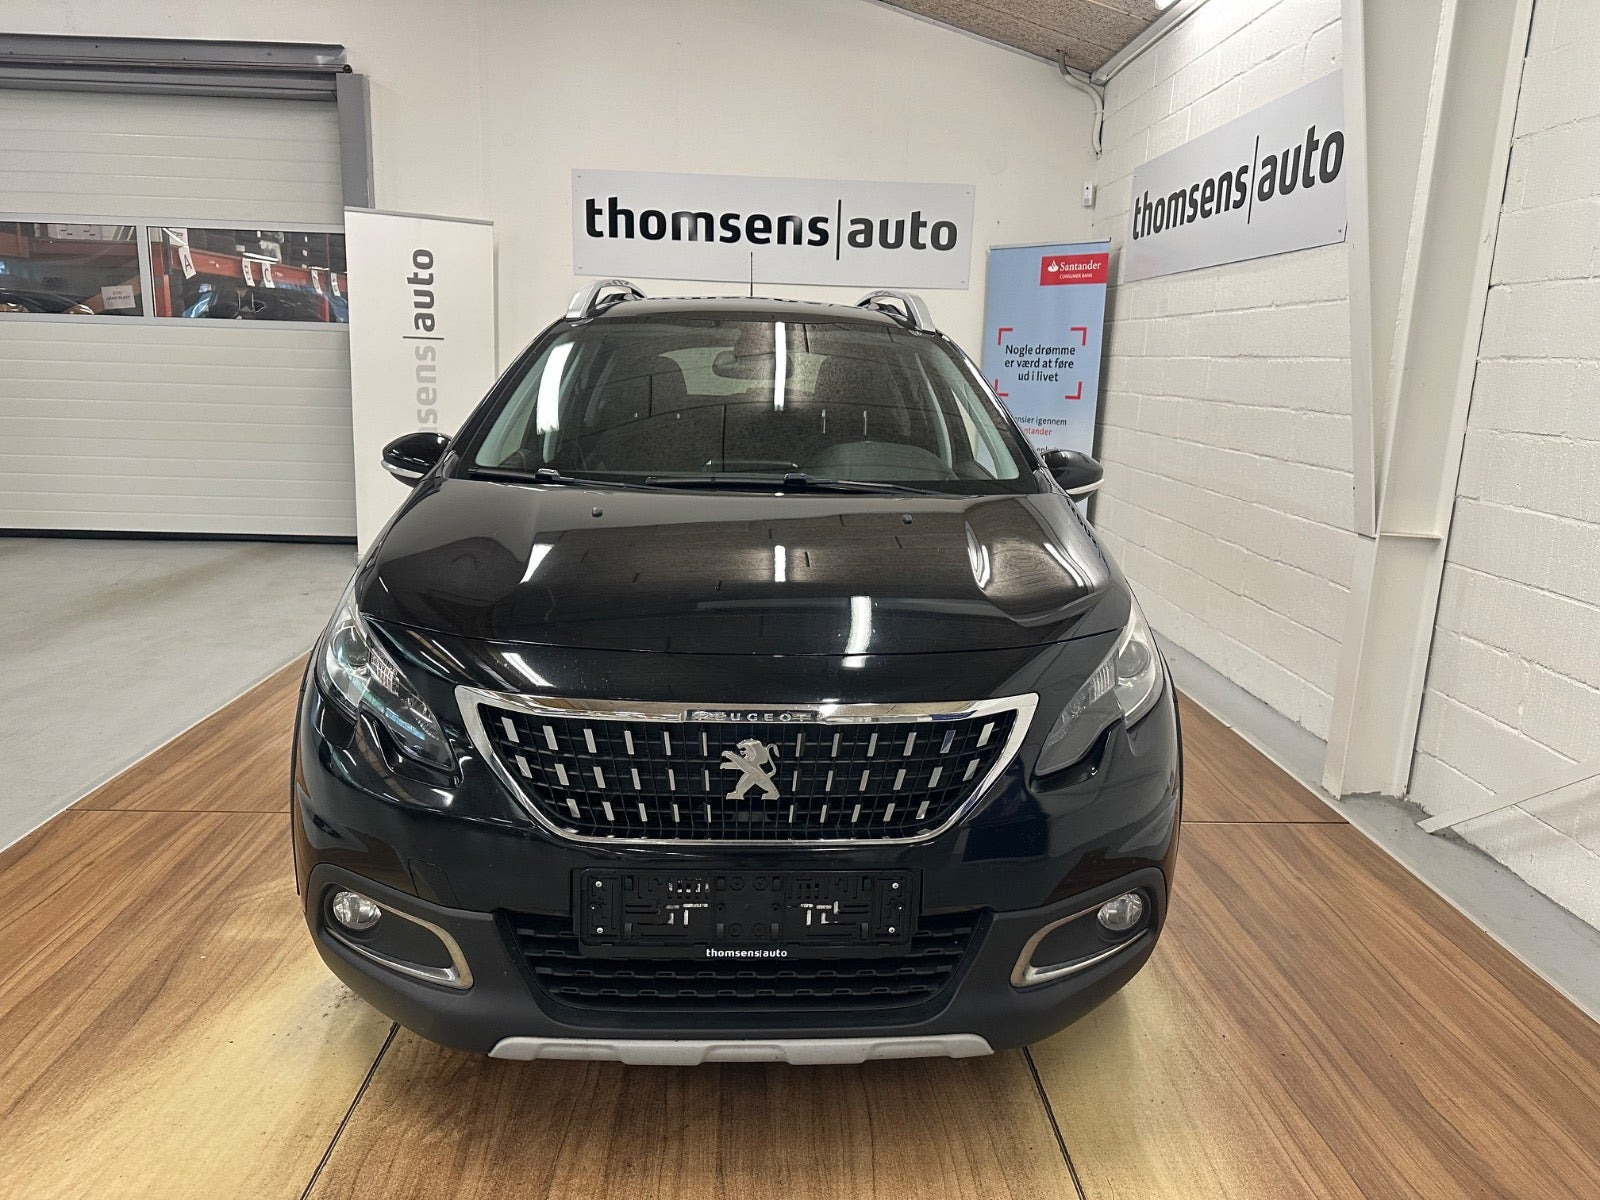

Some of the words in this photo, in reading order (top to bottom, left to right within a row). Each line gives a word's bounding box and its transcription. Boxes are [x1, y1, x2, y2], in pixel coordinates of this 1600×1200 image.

[184, 254, 193, 272] A
[1059, 259, 1102, 272] Santander
[1005, 344, 1033, 358] Nogle
[1035, 344, 1076, 356] drømme
[1004, 359, 1015, 368] er
[1016, 358, 1040, 368] værd
[1042, 359, 1053, 369] at
[1054, 358, 1074, 369] føre
[1018, 371, 1030, 381] ud
[1031, 371, 1035, 381] i
[1036, 371, 1059, 382] livet
[1035, 416, 1067, 426] igennem
[1023, 427, 1052, 436] ntander
